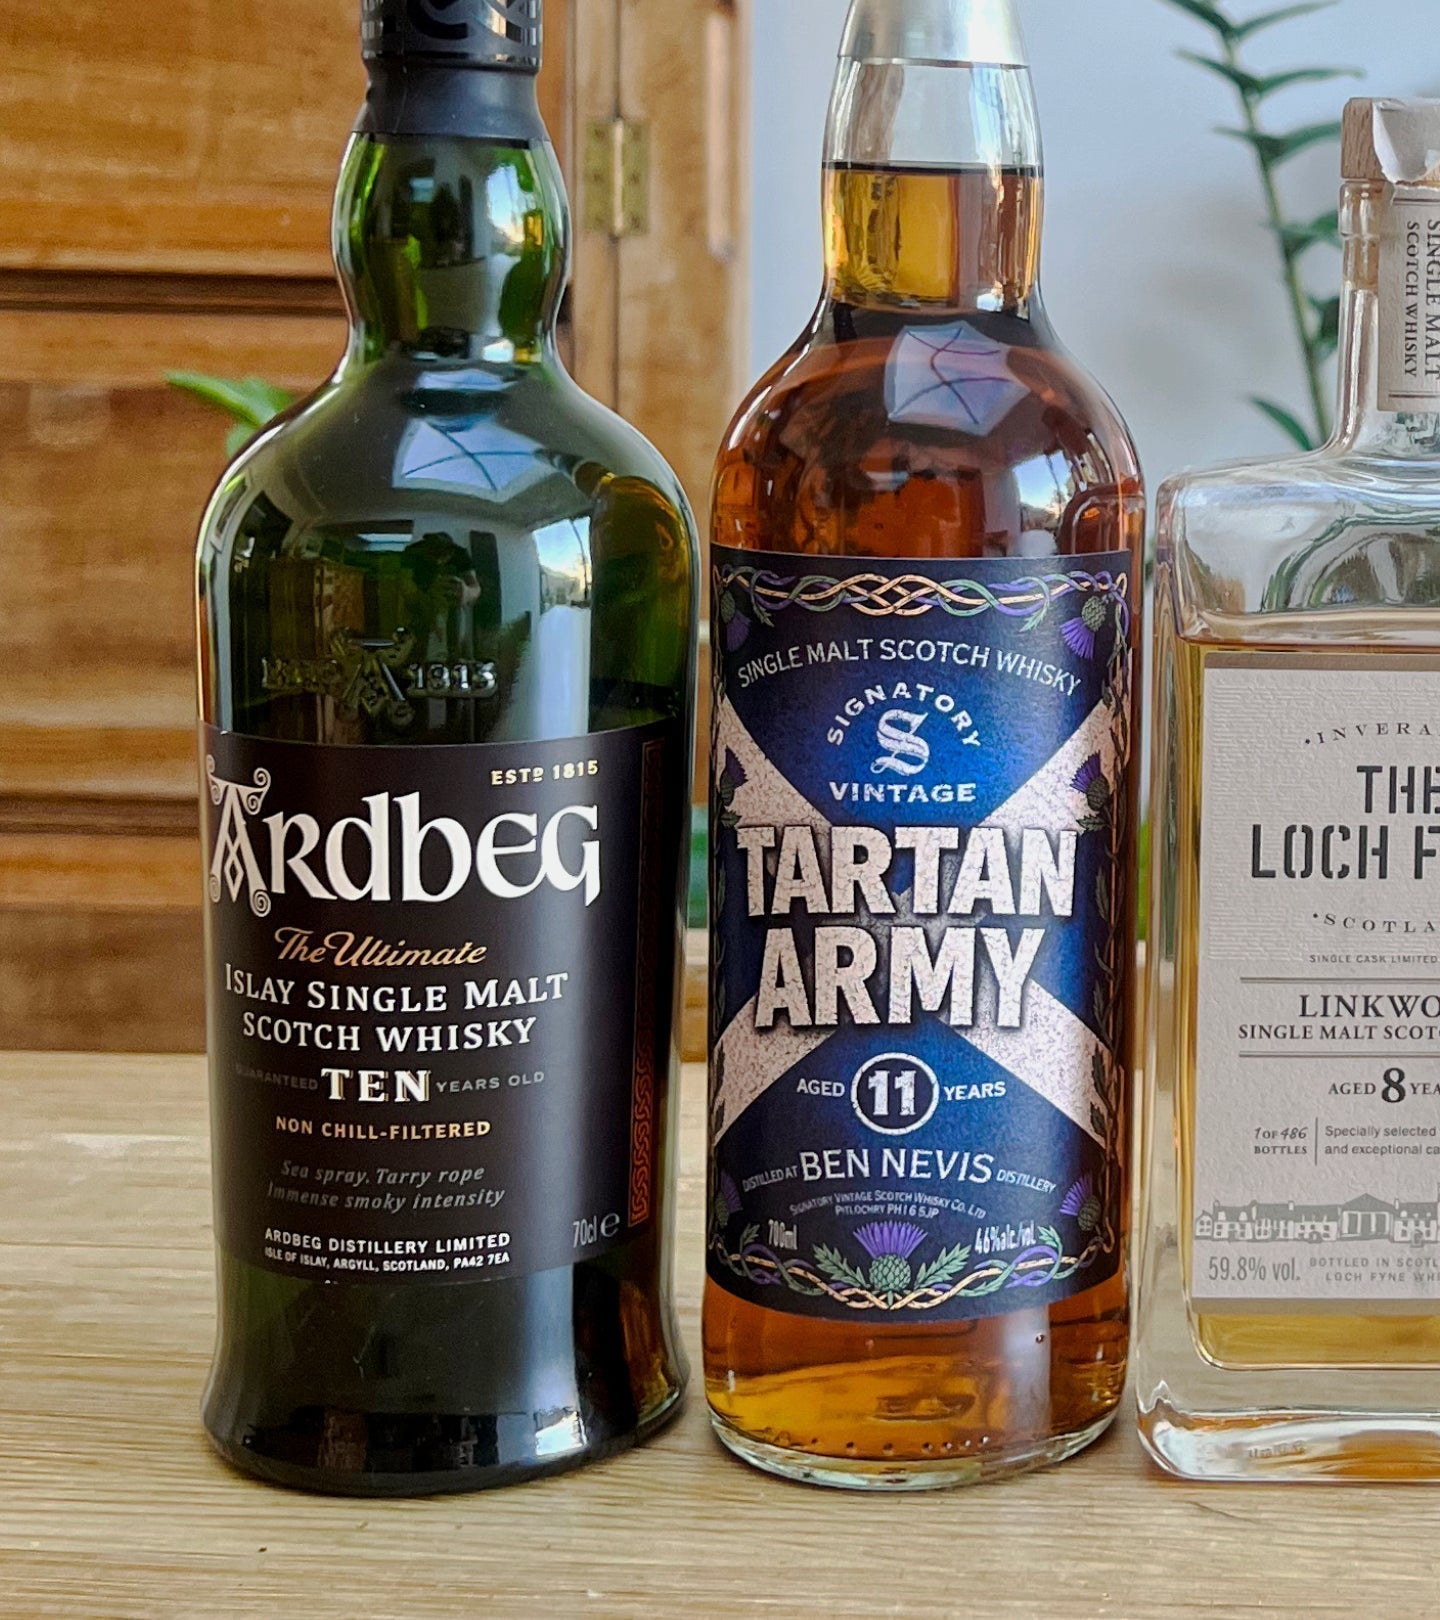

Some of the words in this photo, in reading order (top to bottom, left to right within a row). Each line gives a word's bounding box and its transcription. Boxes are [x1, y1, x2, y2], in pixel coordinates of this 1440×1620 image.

[1406, 220, 1419, 298] SCOTCH
[1404, 303, 1419, 378] WHISKY
[737, 645, 804, 688] SINGLE
[807, 639, 874, 665] MALT
[879, 639, 990, 668] SCOTCH
[996, 650, 1082, 697] WHISKY
[827, 682, 982, 749] SIGNATORY
[553, 760, 598, 779] 1815
[829, 781, 977, 803] VINTAGE
[1251, 823, 1389, 879] LOCH
[736, 825, 1078, 917] TARTAN
[274, 927, 324, 963] The
[323, 931, 487, 967] Ultimate
[1309, 954, 1351, 964] SINGLE
[1356, 954, 1386, 964] CASK
[1391, 954, 1438, 964] LIMITED
[225, 963, 295, 1005] ISLAY
[307, 980, 447, 1012] SINGLE
[464, 972, 569, 1010] MALT
[755, 925, 1046, 1028] ARMY
[243, 1012, 360, 1051] SCOTCH
[376, 1017, 537, 1052] WHISKY
[1238, 1024, 1313, 1040] SINGLE
[1319, 1024, 1378, 1040] MALT
[320, 1068, 432, 1101] TEN
[436, 1077, 500, 1092] YEARS
[508, 1071, 545, 1086] OLD
[797, 1077, 845, 1098] AGED
[867, 1069, 917, 1116] 11
[943, 1081, 1007, 1102] YEARS
[1328, 1082, 1376, 1096] AGED
[1381, 1067, 1406, 1103] 8
[276, 1115, 313, 1135] NON
[321, 1120, 491, 1140] CHILL-FILTERED
[1325, 1125, 1380, 1140] Specially
[1383, 1125, 1436, 1138] selected
[1254, 1145, 1307, 1155] BOTTLES
[1325, 1143, 1348, 1155] and
[1351, 1143, 1423, 1158] exceptional
[281, 1160, 308, 1179] Sea
[376, 1168, 430, 1188] Tarry
[438, 1166, 485, 1186] rope
[742, 1170, 785, 1194] DISTILLED
[785, 1165, 798, 1180] AT
[799, 1149, 869, 1182] BEN
[881, 1149, 994, 1184] NEVIS
[997, 1170, 1057, 1194] DISTILLERY
[268, 1181, 338, 1208] Immense
[345, 1194, 404, 1214] smoky
[412, 1187, 505, 1210] intensity
[265, 1227, 322, 1251] ARDBEG
[329, 1236, 428, 1256] DISTILLERY
[435, 1232, 510, 1253] LIMITED
[572, 1215, 598, 1248] 70cl
[300, 1252, 330, 1270] ISLAY,
[332, 1256, 380, 1272] ARGYLL,
[382, 1257, 450, 1272] SCOTLAND,
[453, 1254, 485, 1270] PA42
[487, 1251, 510, 1265] 7EA
[1208, 1257, 1267, 1281] 59.8%
[1273, 1258, 1300, 1281] vol.
[1309, 1257, 1369, 1267] BOTTLED
[1376, 1258, 1389, 1267] IN
[1325, 1272, 1363, 1282] LOCH
[1370, 1272, 1406, 1282] FYNE
